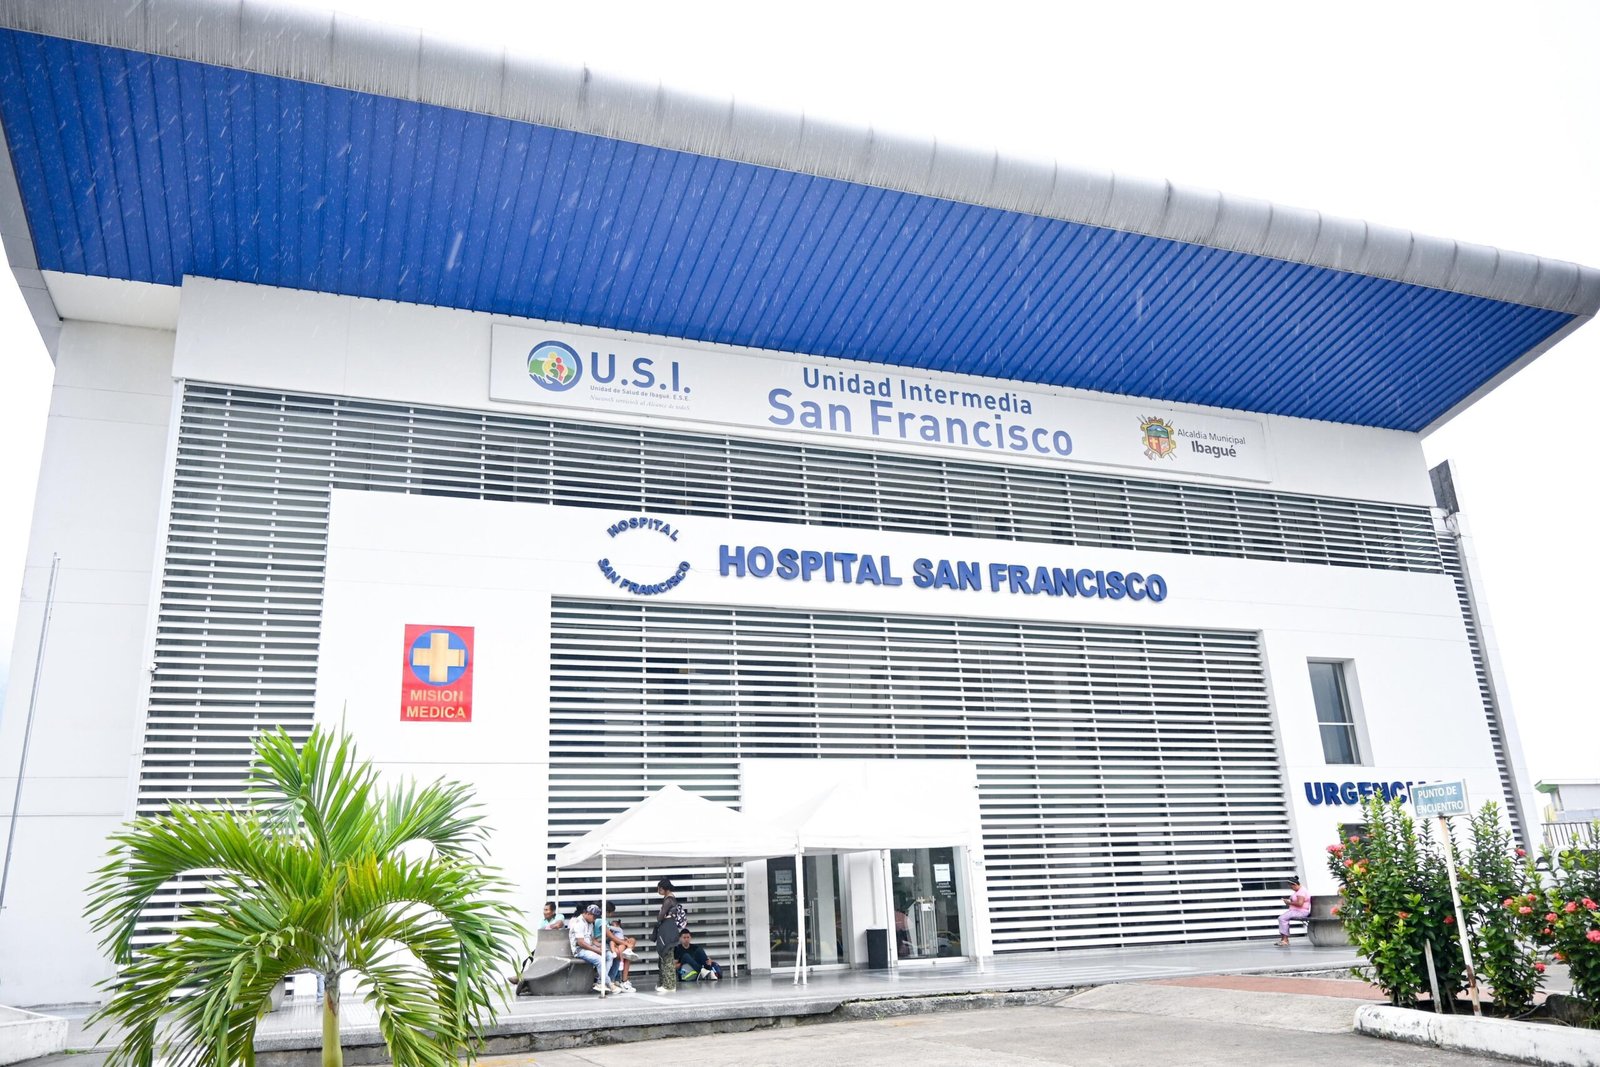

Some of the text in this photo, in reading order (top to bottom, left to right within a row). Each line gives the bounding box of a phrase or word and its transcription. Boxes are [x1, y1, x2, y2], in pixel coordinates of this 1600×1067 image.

[591, 352, 691, 394] U.S.I.
[590, 385, 612, 393] Unidad
[803, 367, 1032, 414] Unidad Intermedia
[768, 388, 1073, 456] San Francisco
[1209, 433, 1246, 445] Municipal
[1191, 440, 1236, 458] Ibagué
[607, 517, 679, 542] HOSPITAL
[598, 558, 690, 595] SAN FRANCISCO
[719, 545, 1168, 602] HOSPITAL SAN FRANCISCO
[410, 689, 464, 702] MISION
[406, 705, 466, 718] MEDICA
[1417, 785, 1458, 799] PUNTO DE
[1416, 800, 1464, 814] ENCUENTRO
